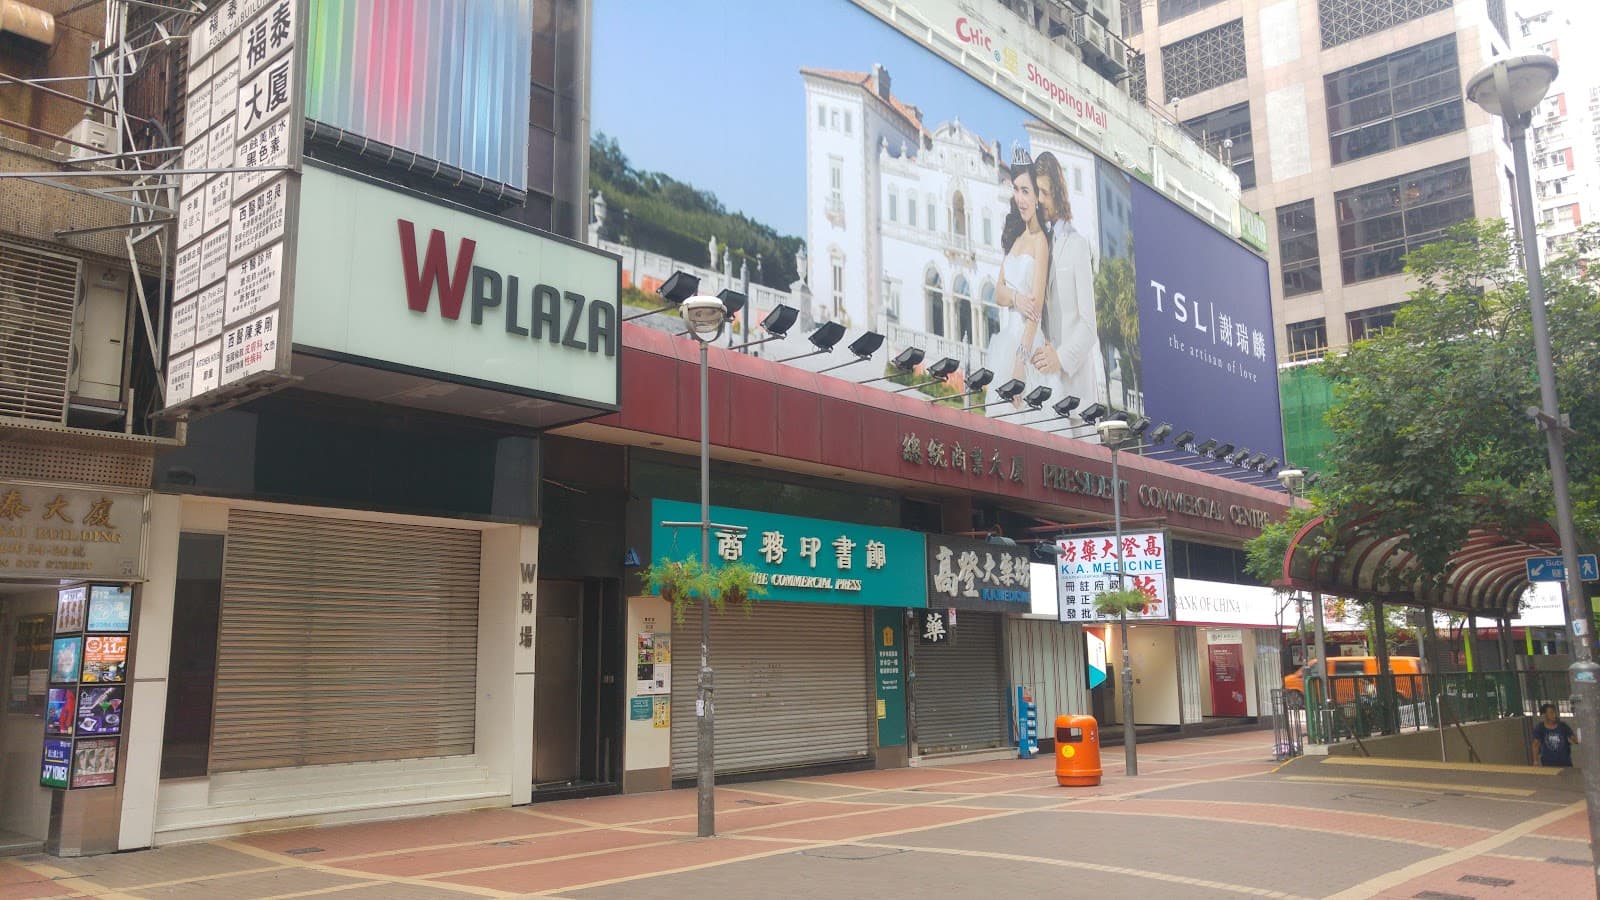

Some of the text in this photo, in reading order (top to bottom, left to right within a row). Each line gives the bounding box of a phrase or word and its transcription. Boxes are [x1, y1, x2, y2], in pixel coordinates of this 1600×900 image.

[246, 1, 291, 70] 福泰
[243, 60, 289, 130] 大廈
[1027, 63, 1107, 129] Shopping Mall
[471, 265, 615, 356] PLAZA
[1151, 280, 1207, 332] TSL
[1168, 334, 1257, 383] the artisan of love
[1218, 312, 1267, 362] 謝瑞麟
[901, 432, 1024, 482] 總統商業大廈
[1043, 463, 1129, 504] PRESIDENT
[1139, 484, 1225, 521] COMMERCIAL
[771, 574, 833, 589] COMMERCIAL
[835, 578, 862, 591] PRESS
[1092, 558, 1163, 574] MEDICINE
[923, 612, 947, 642] 藥
[1199, 596, 1211, 612] OF
[1213, 597, 1241, 613] CHINA
